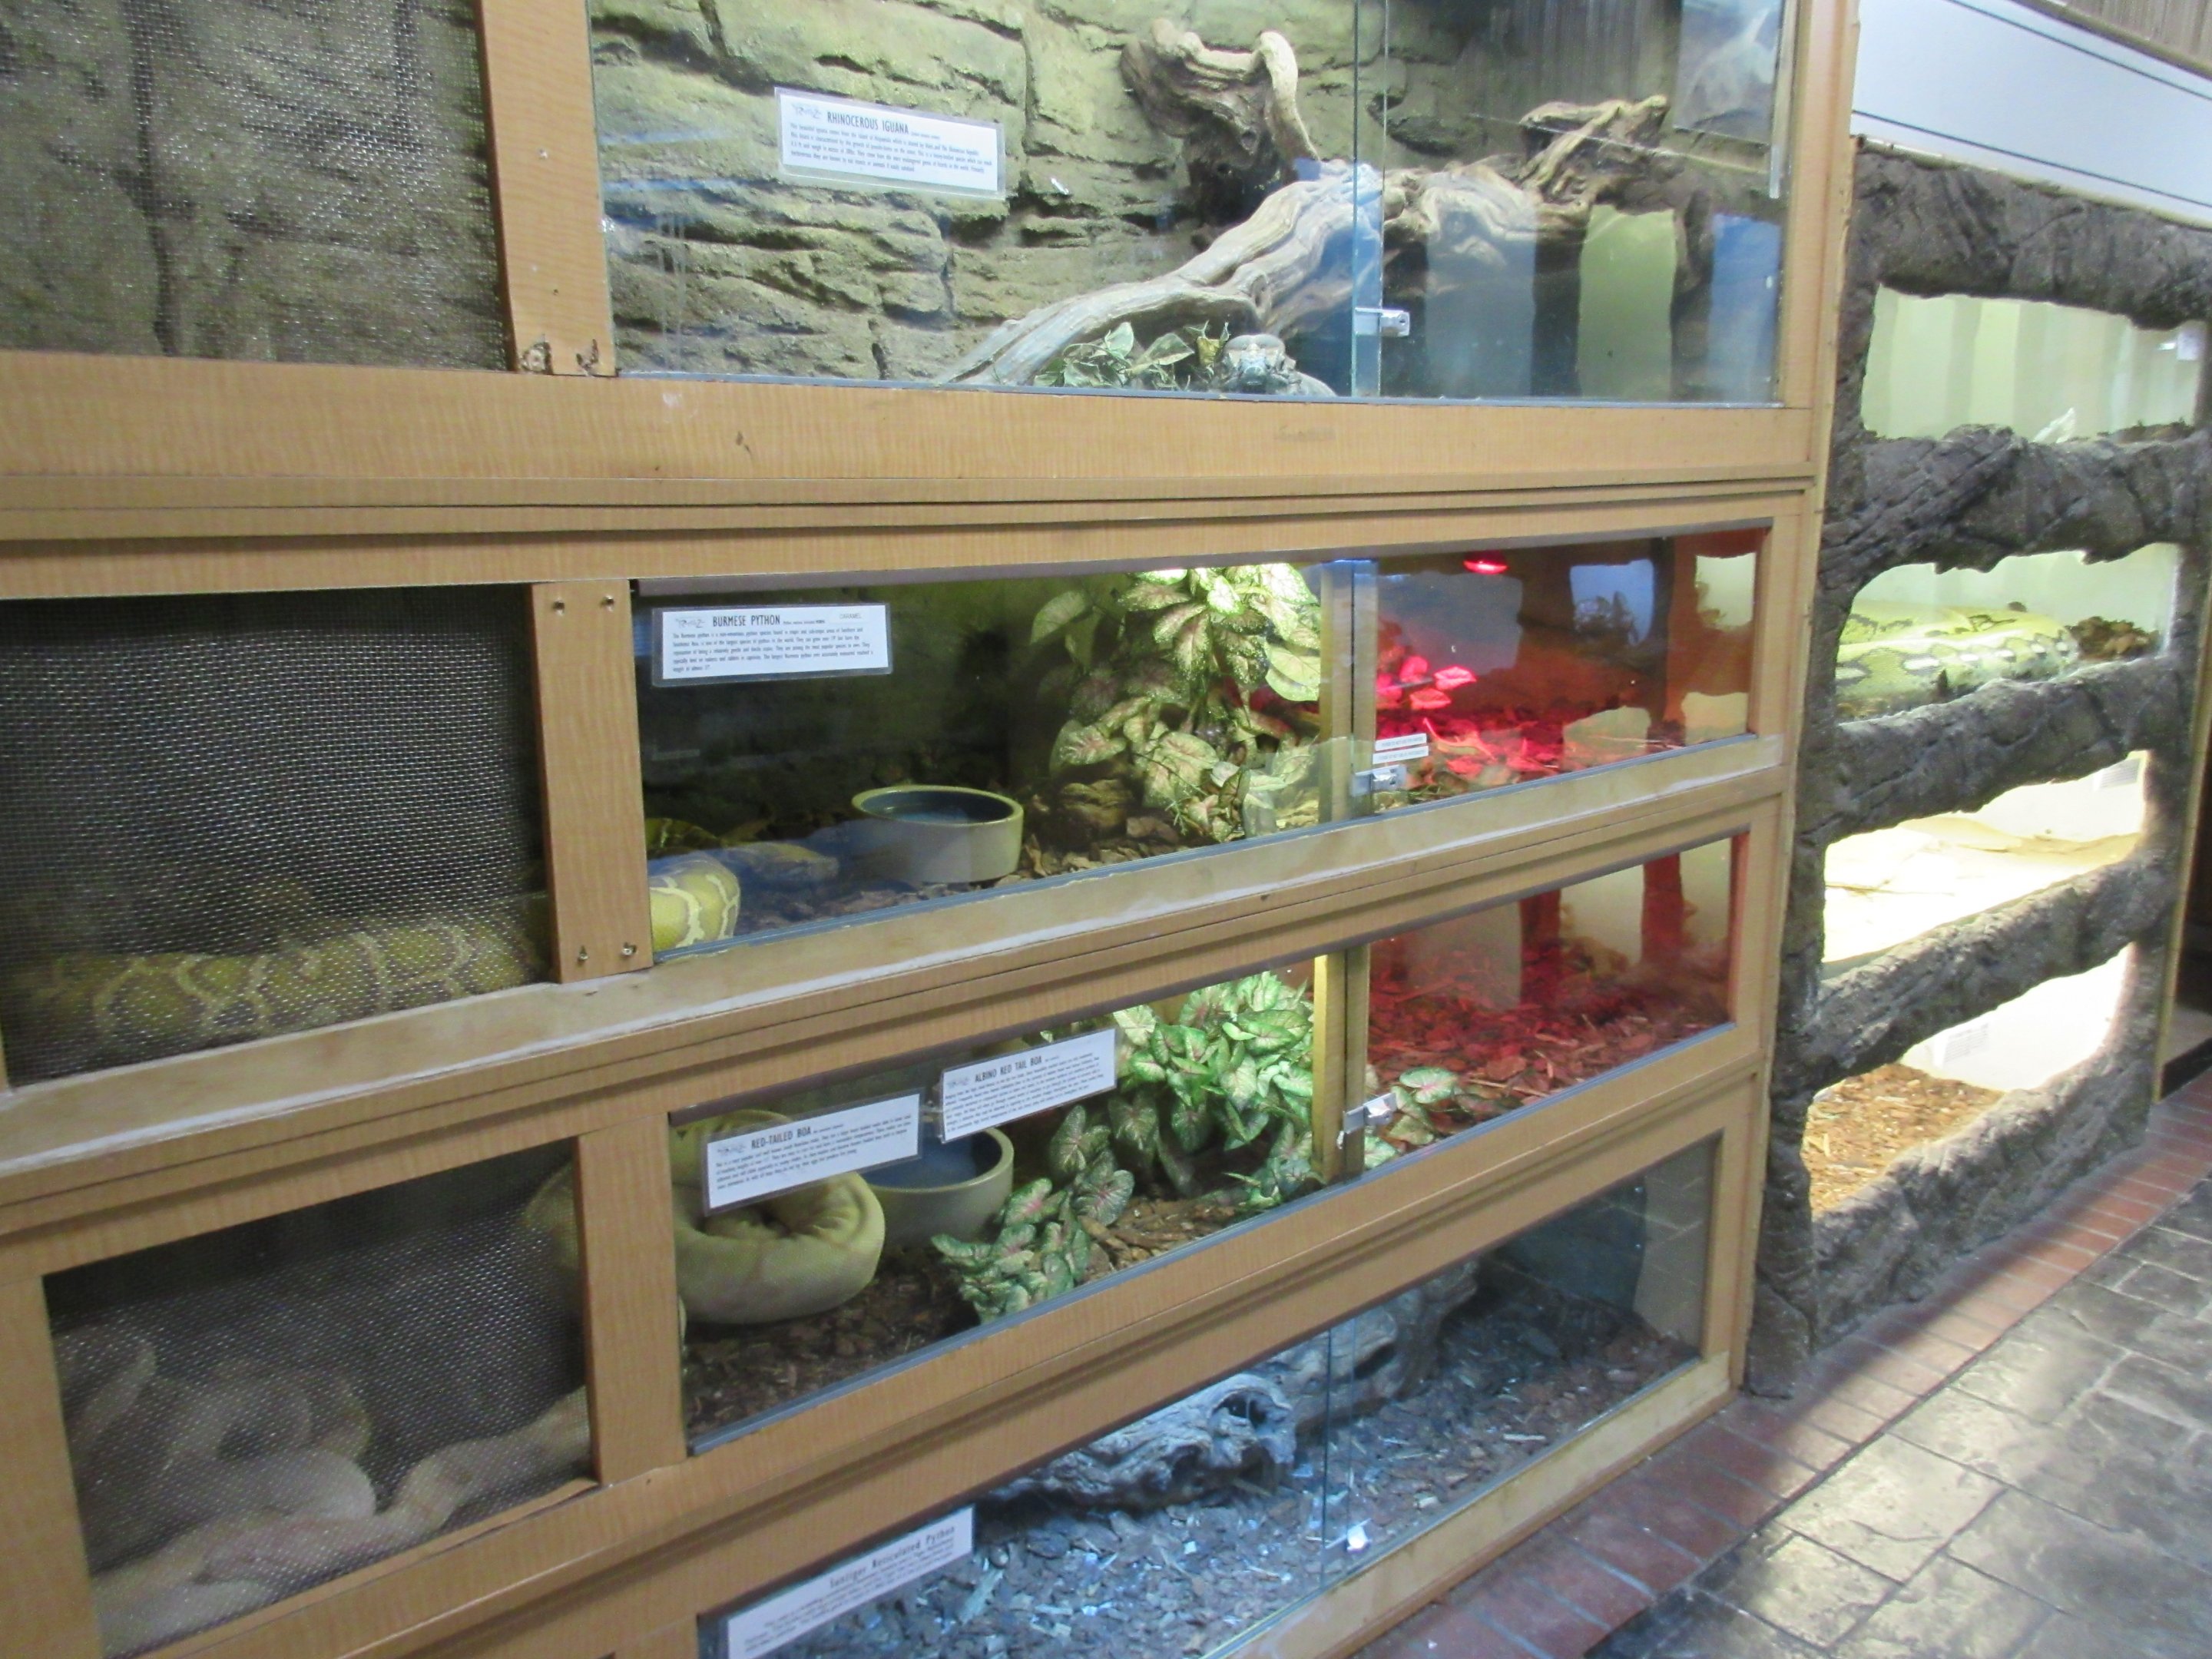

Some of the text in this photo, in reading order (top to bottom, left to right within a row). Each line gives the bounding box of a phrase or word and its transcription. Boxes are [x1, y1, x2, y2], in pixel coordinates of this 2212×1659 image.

[827, 111, 879, 131] RHINOCEROUS
[882, 120, 909, 134] IGUANA
[713, 616, 747, 627] BURMESE
[750, 615, 780, 625] PYTHON
[975, 1068, 997, 1082] ALBINO
[1000, 1064, 1012, 1075] RED
[1015, 1060, 1027, 1070] TAIL
[1030, 1055, 1041, 1067] BOA
[751, 1131, 793, 1149] RED-TAILED
[797, 1126, 811, 1137] BOA
